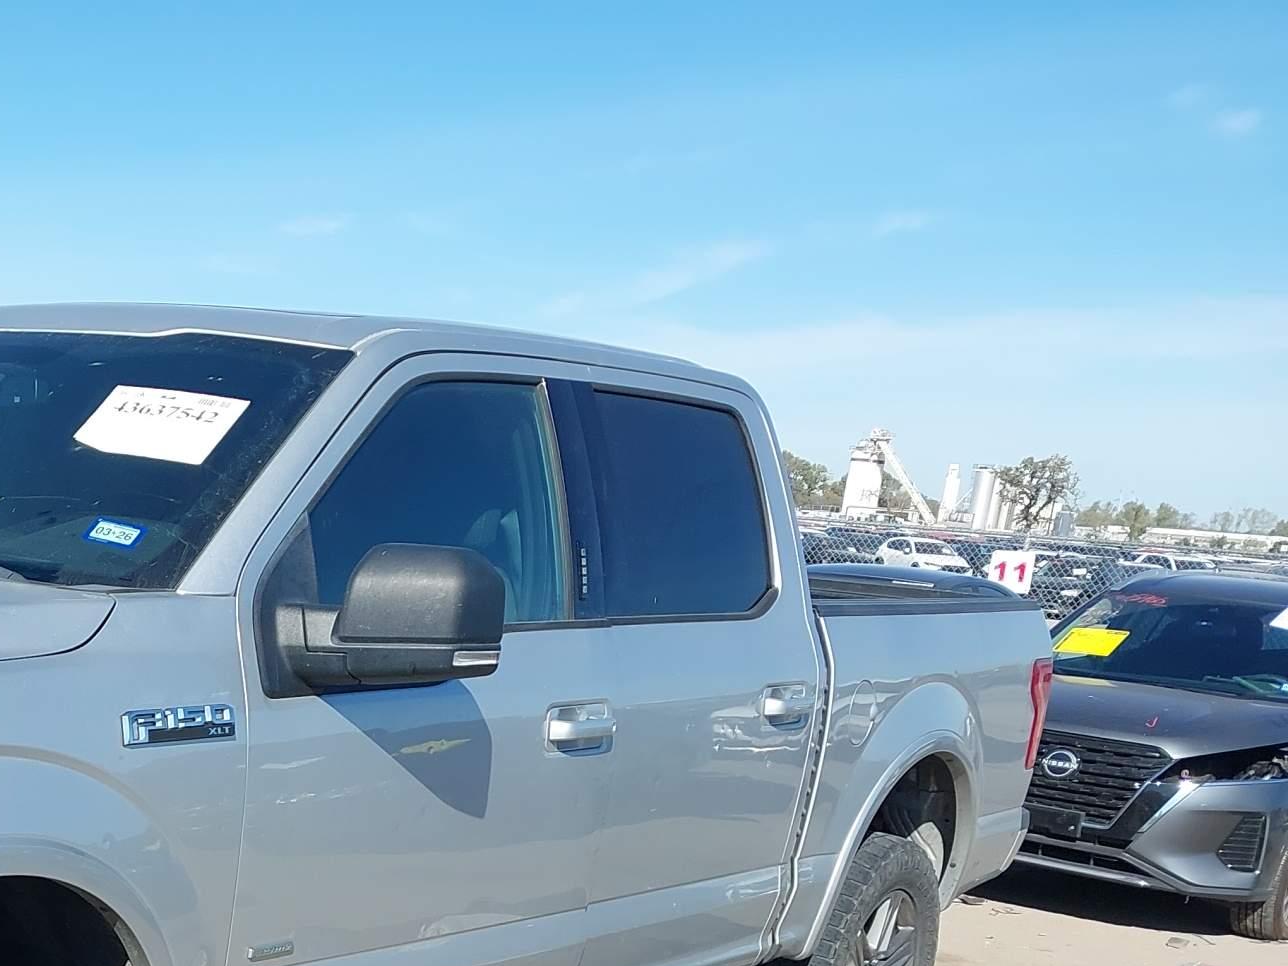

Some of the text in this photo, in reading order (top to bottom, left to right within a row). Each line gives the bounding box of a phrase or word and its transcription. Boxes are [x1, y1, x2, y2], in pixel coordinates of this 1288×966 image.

[113, 400, 219, 424] 43637542
[994, 560, 1028, 583] 11
[208, 726, 231, 736] XLT
[1041, 758, 1079, 770] NISSAN
